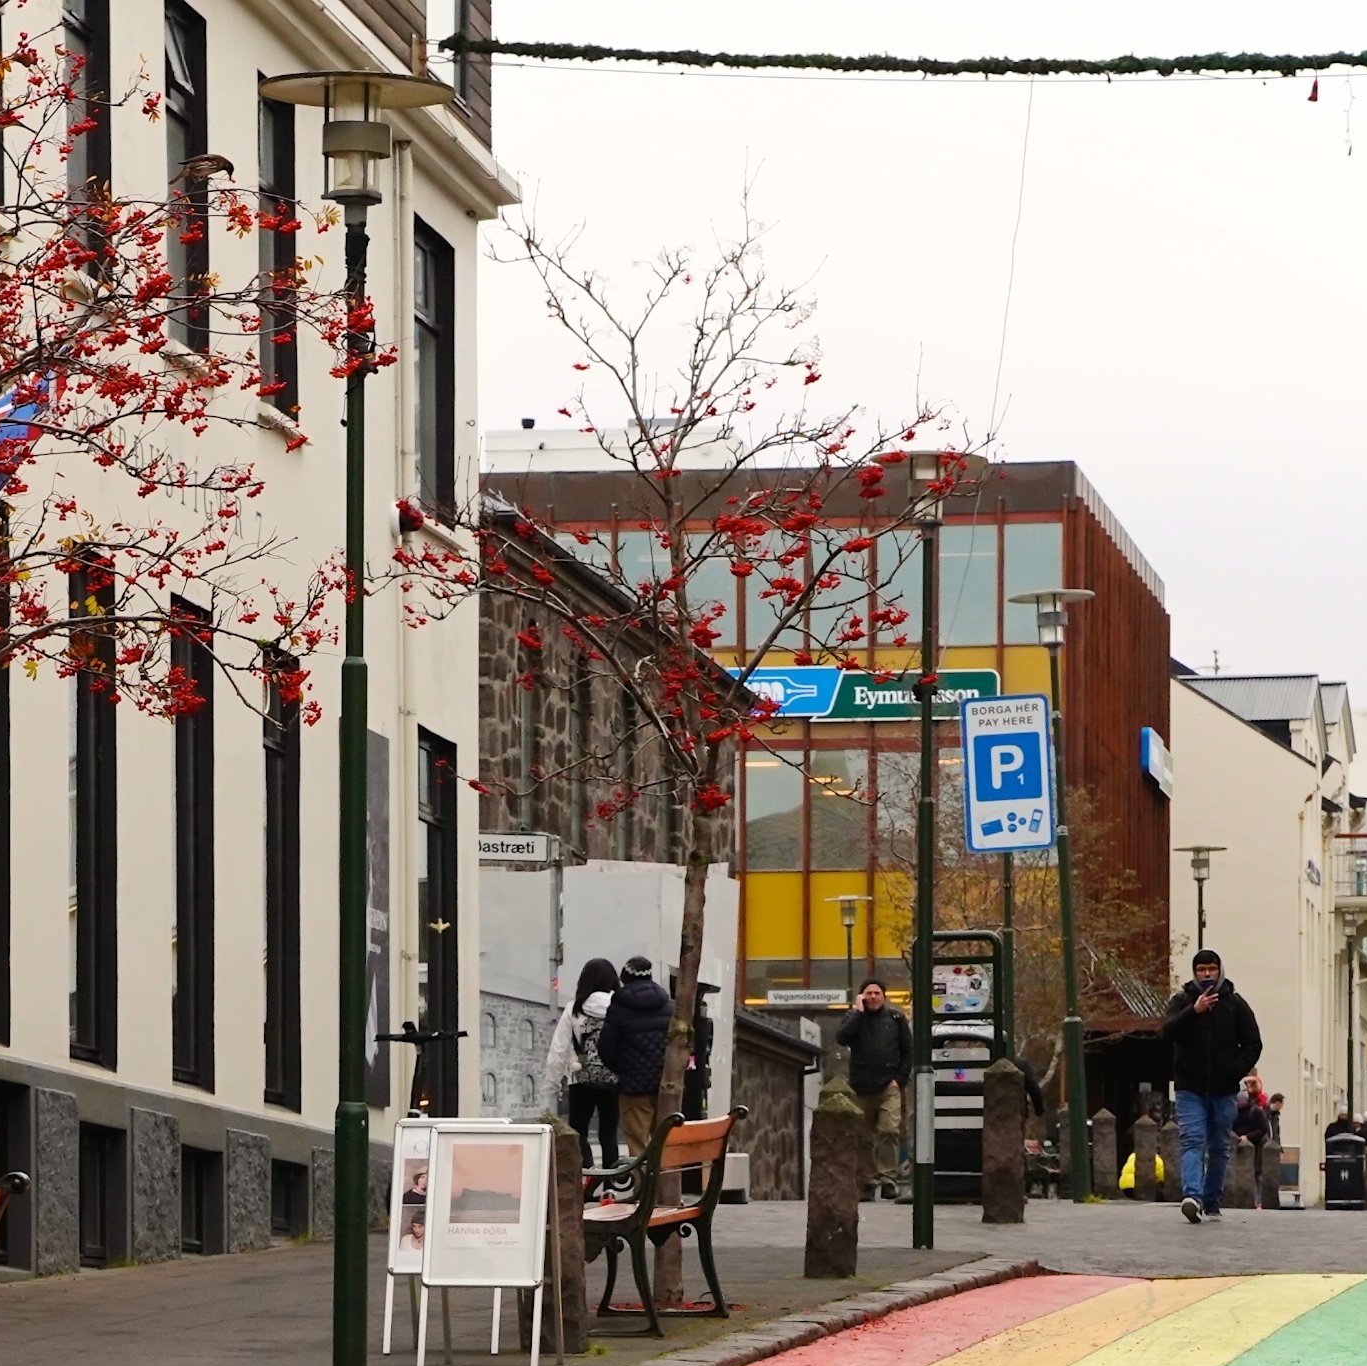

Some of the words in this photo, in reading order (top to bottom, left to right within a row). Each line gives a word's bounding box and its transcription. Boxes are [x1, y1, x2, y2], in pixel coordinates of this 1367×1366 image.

[853, 685, 980, 709] Eymusson
[971, 705, 1012, 716] BORGA
[1015, 702, 1039, 713] HÉR
[978, 718, 999, 728] PAY
[1002, 715, 1034, 726] HERE
[990, 744, 1025, 790] P
[447, 1226, 481, 1235] HANNA
